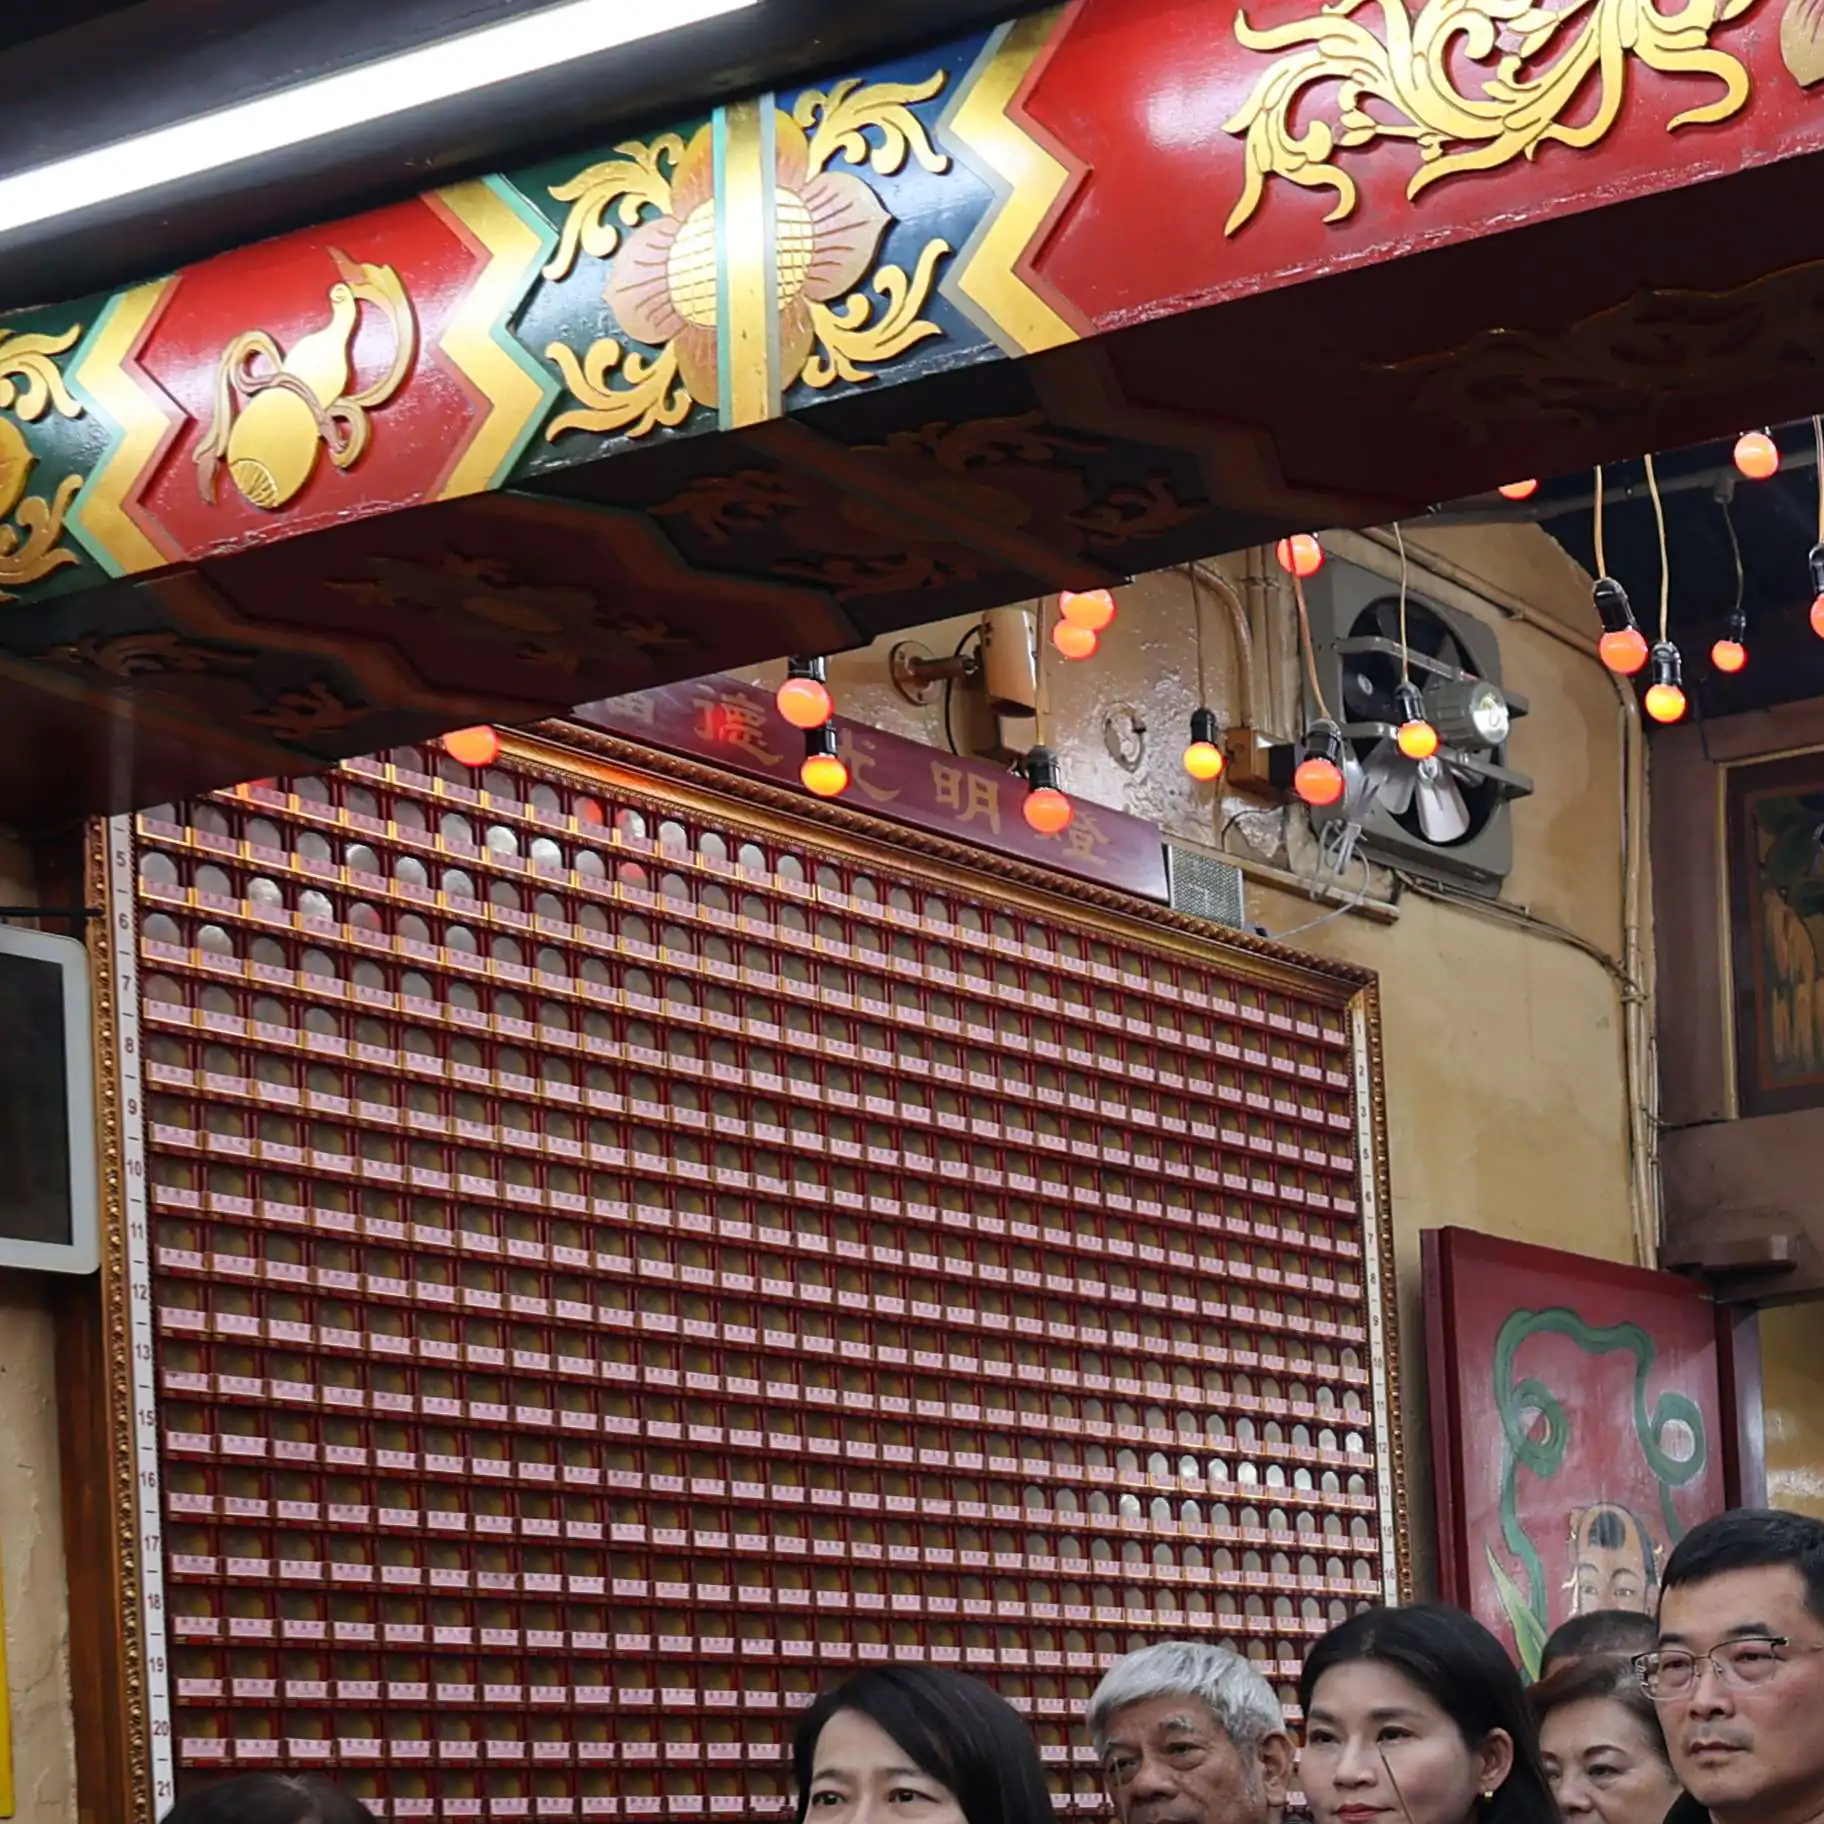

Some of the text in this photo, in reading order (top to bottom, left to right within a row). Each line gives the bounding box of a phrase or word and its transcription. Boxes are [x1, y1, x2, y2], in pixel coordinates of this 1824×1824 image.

[116, 851, 126, 866] 5
[119, 913, 129, 928] 6
[121, 976, 131, 991] 7
[124, 1037, 135, 1053] 8
[127, 1099, 138, 1115] 9
[126, 1161, 143, 1176] 10
[130, 1223, 144, 1238] 11
[133, 1284, 148, 1299] 12
[136, 1344, 151, 1360] 13
[139, 1409, 154, 1426] 15
[140, 1471, 155, 1488] 16
[144, 1535, 159, 1551] 17
[146, 1594, 161, 1610] 18
[148, 1657, 164, 1673] 19
[153, 1720, 169, 1736] 20
[156, 1781, 172, 1797] 21
